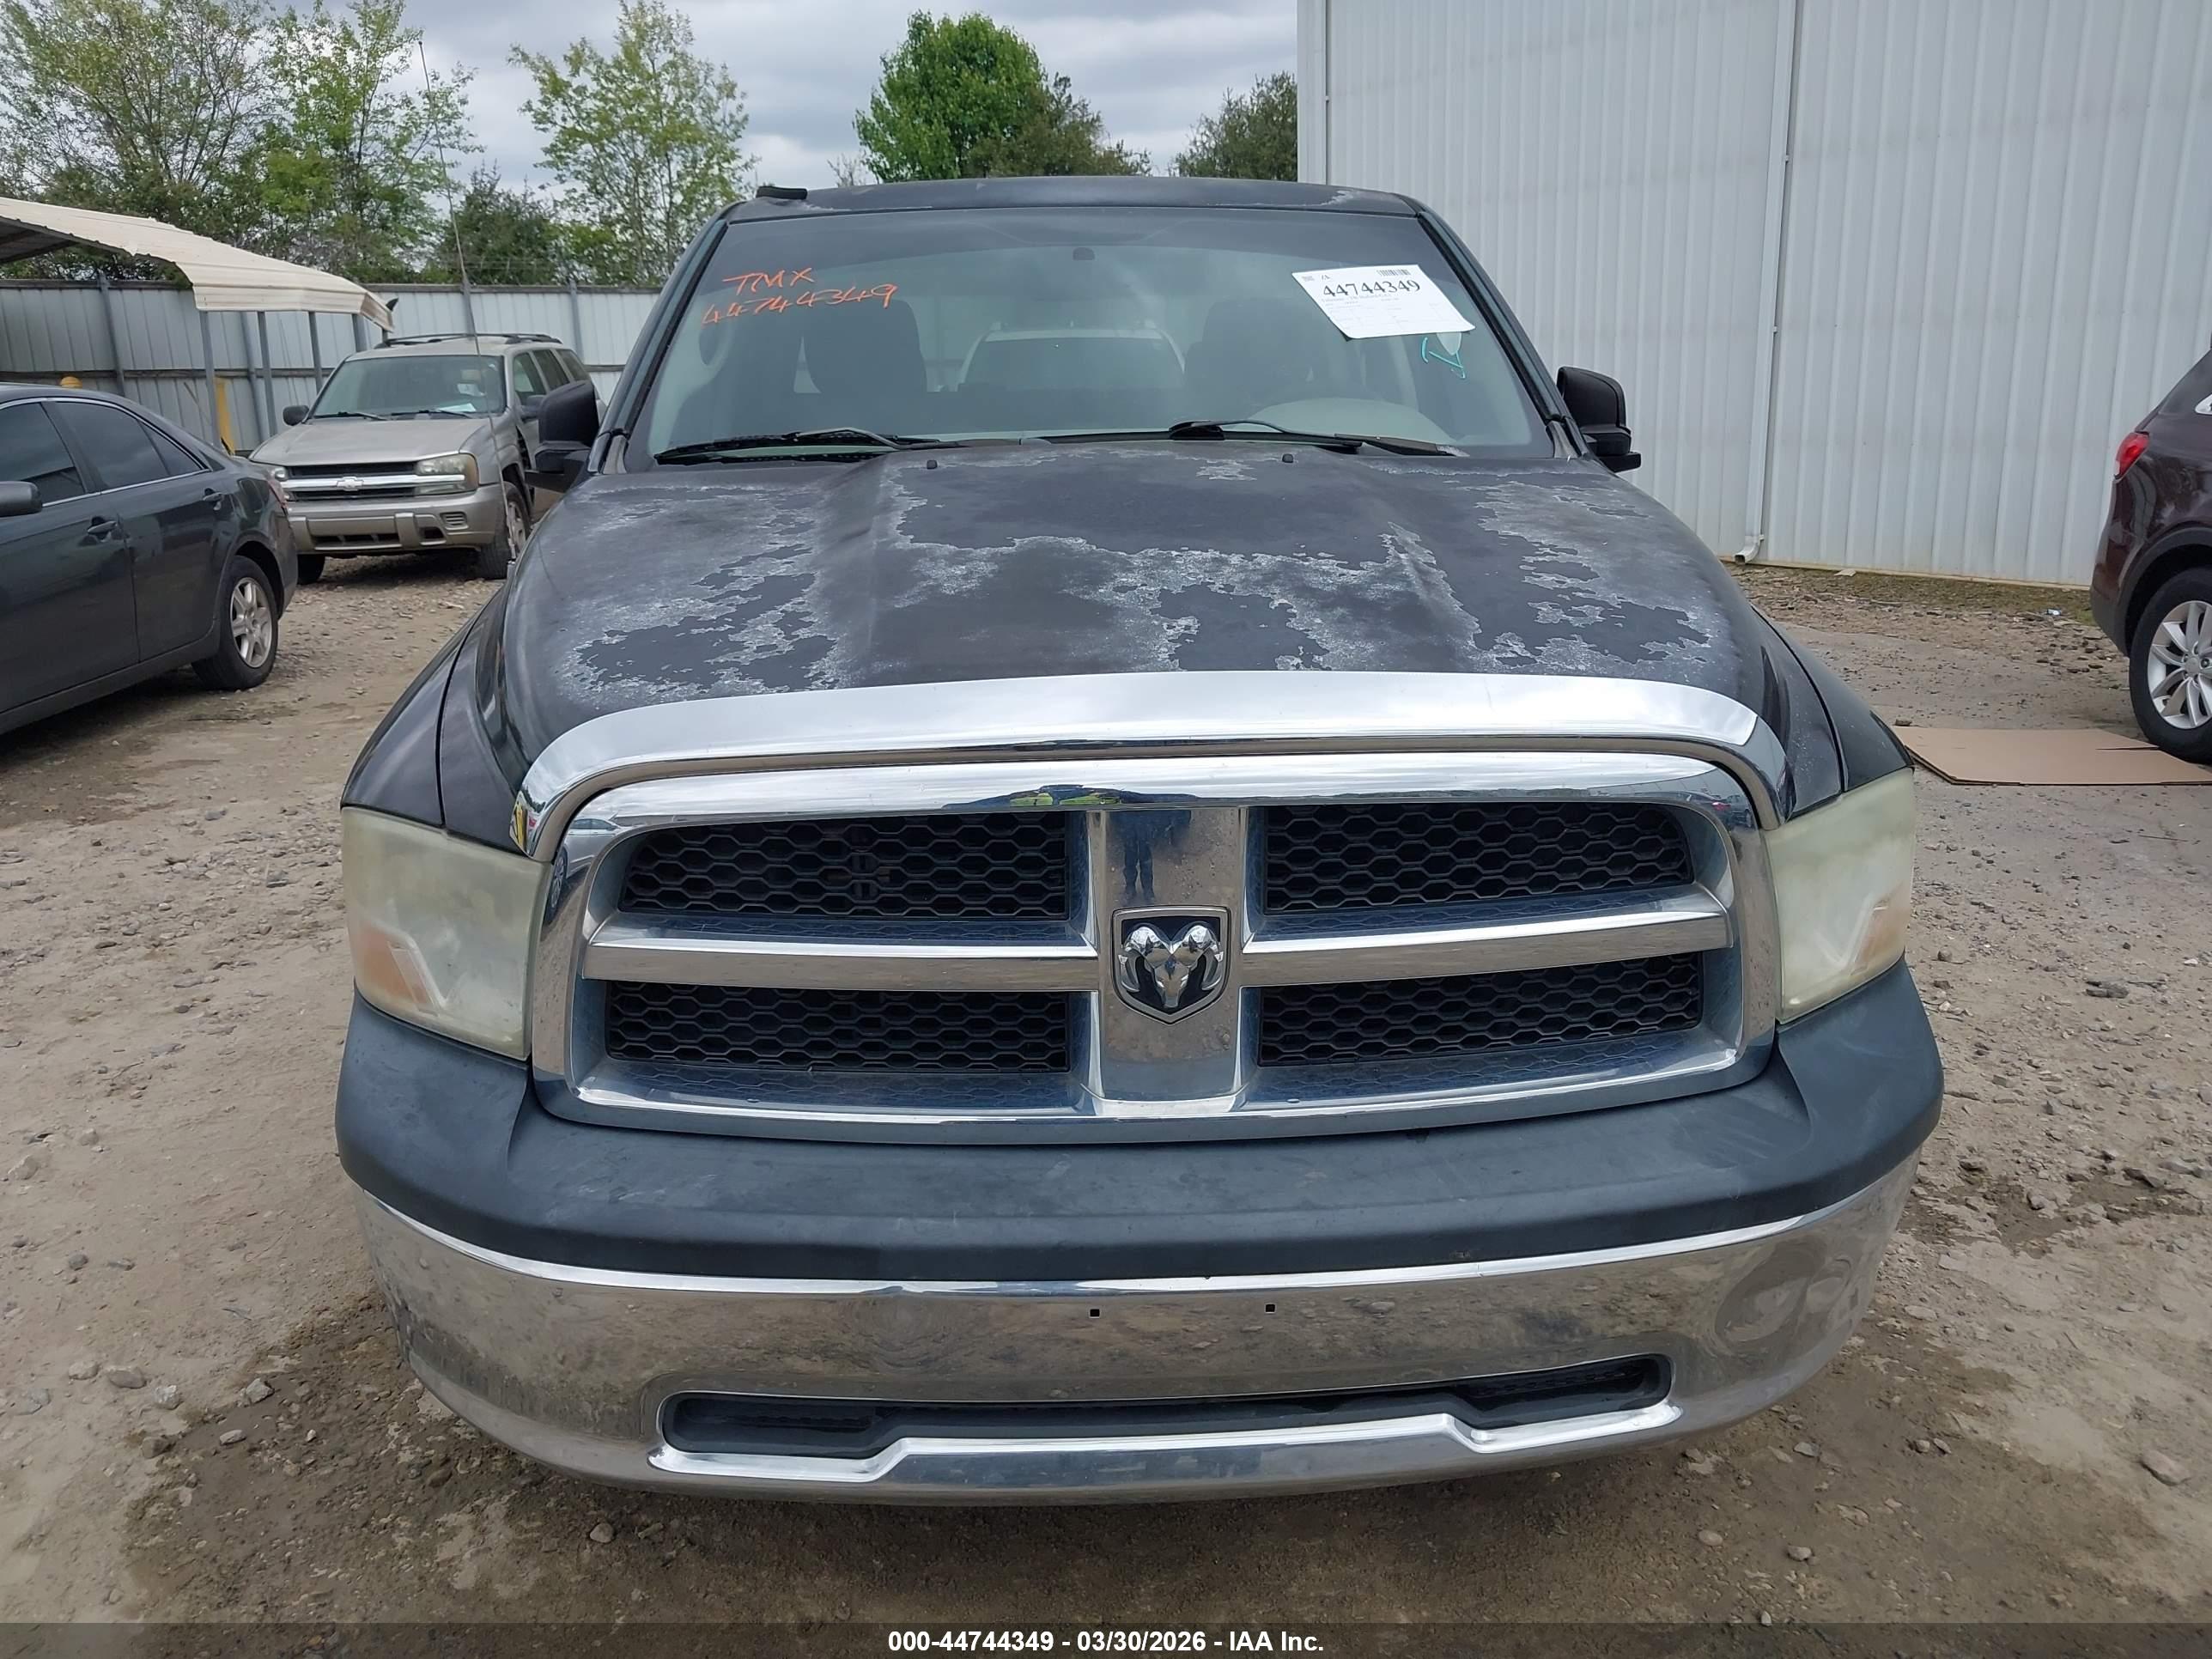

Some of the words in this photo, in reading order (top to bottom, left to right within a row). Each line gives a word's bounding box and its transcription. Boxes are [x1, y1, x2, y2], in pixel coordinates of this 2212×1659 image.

[722, 267, 815, 295] TMX
[1322, 279, 1421, 298] 44744349
[702, 283, 898, 328] 44744349
